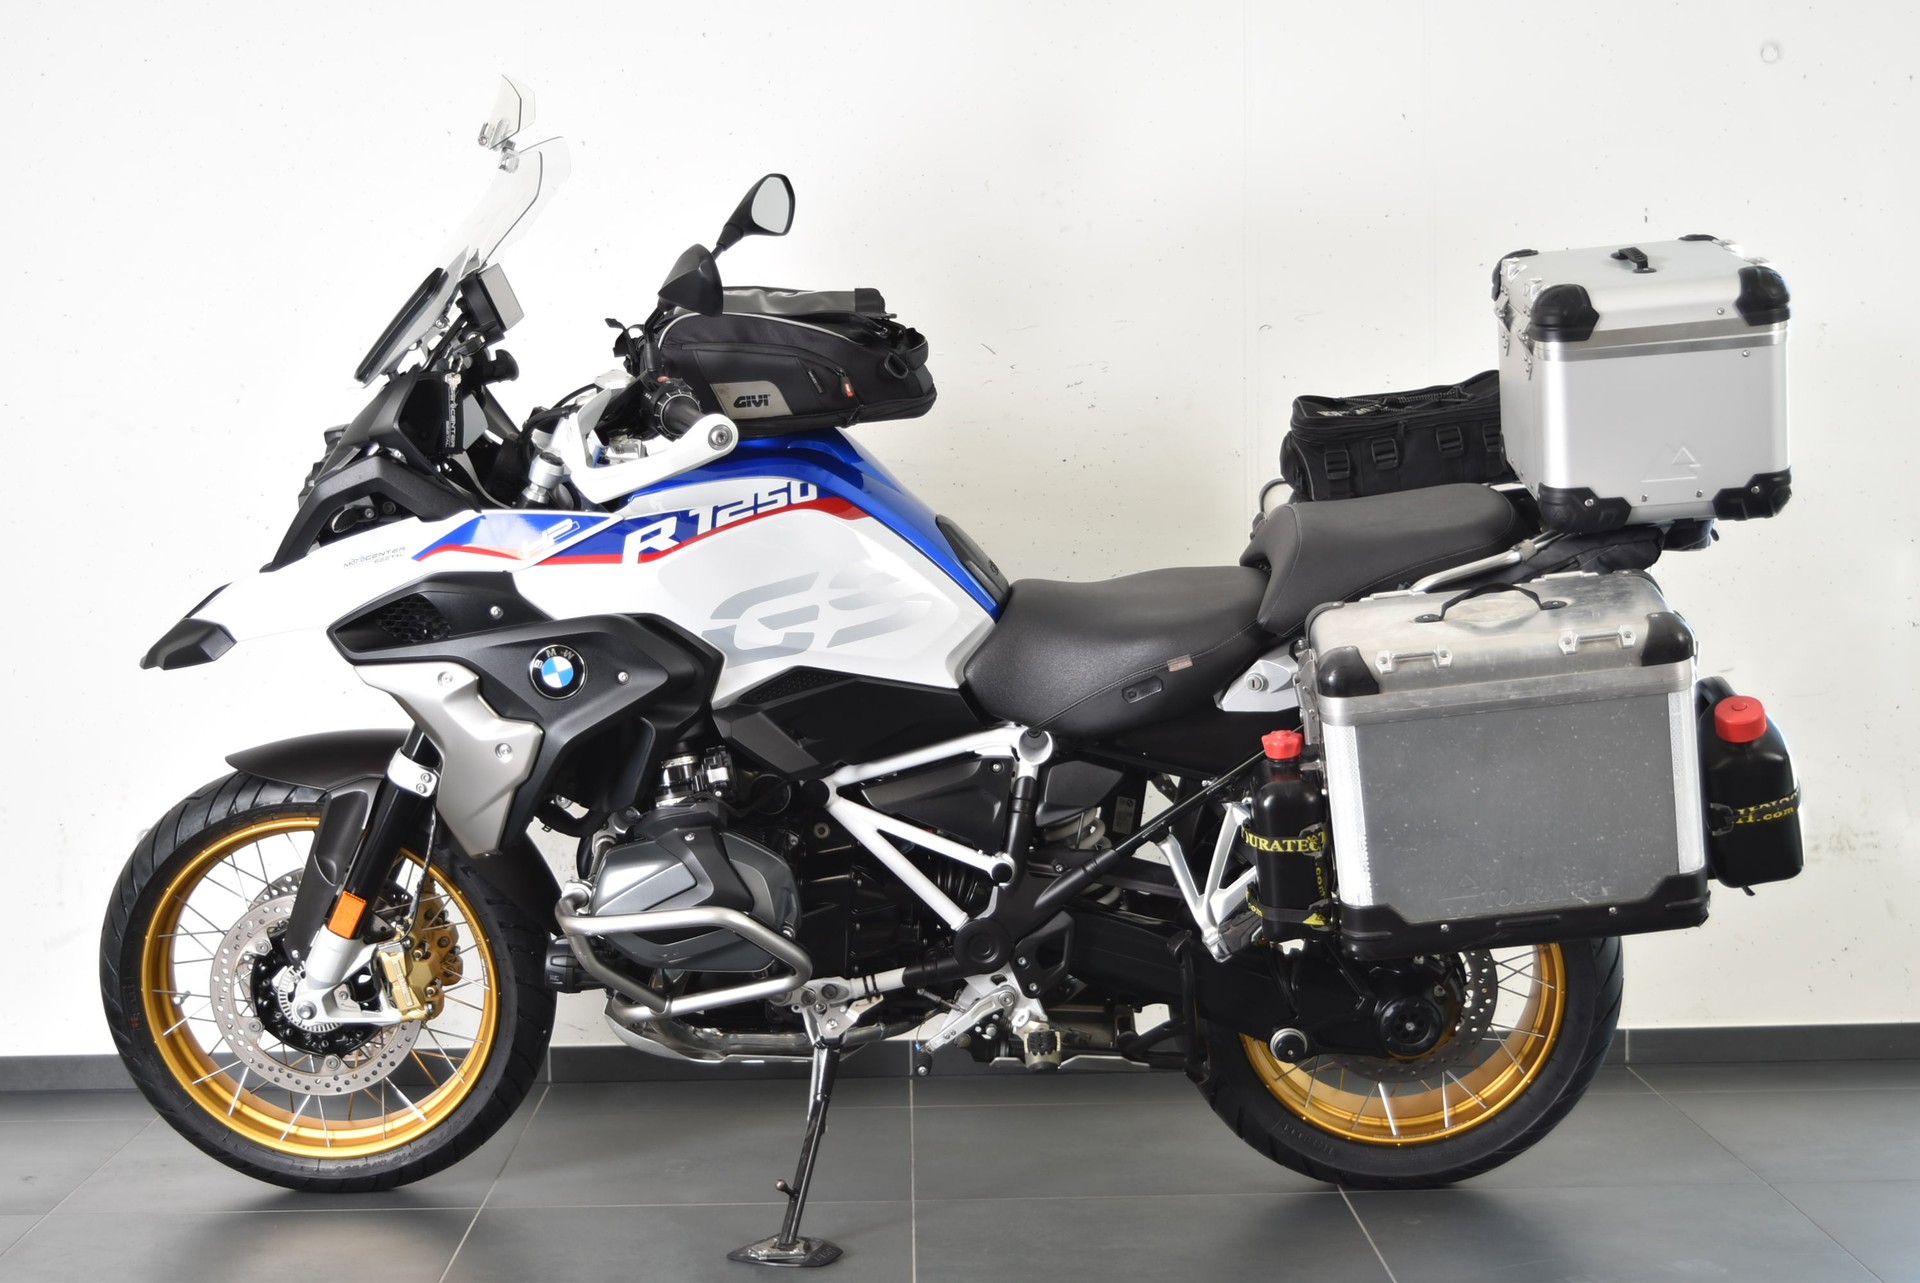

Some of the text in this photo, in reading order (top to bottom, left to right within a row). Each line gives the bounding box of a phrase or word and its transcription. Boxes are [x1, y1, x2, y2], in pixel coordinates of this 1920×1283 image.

[733, 394, 769, 408] GIVI
[622, 481, 817, 564] R 1250
[533, 648, 575, 669] BMW
